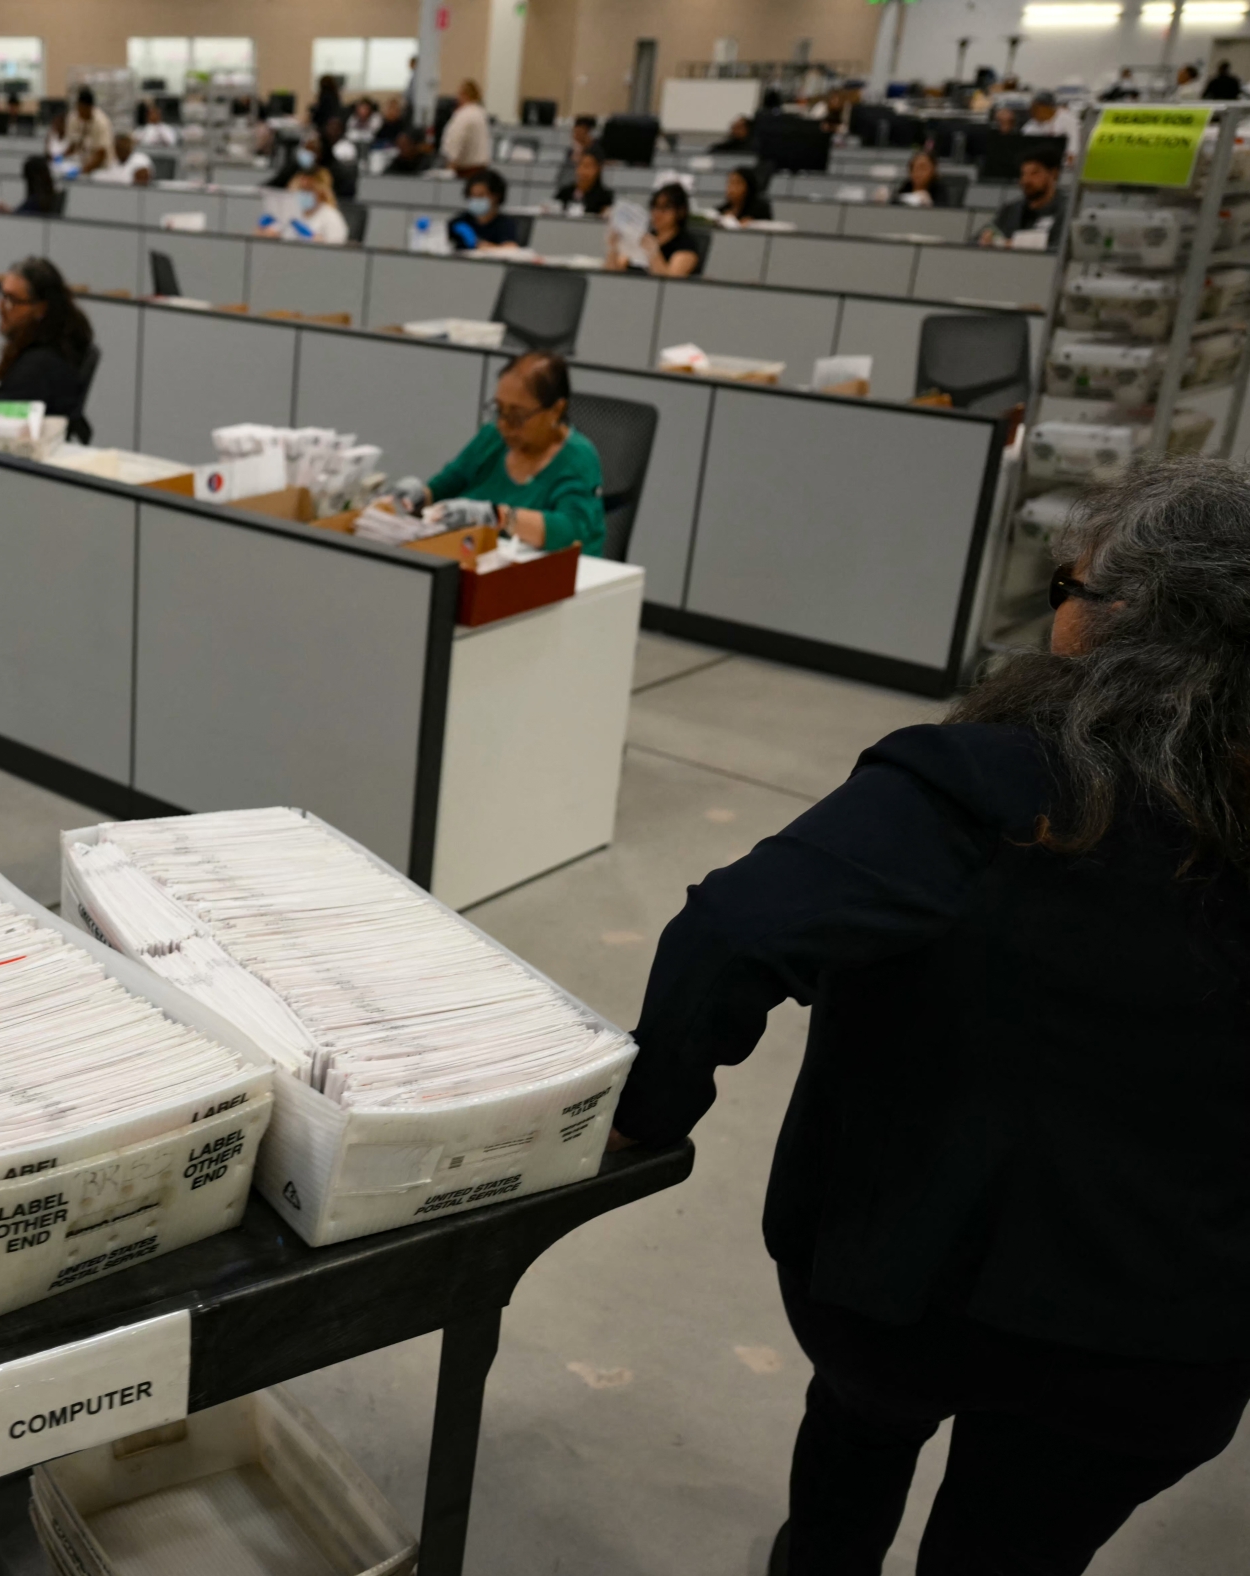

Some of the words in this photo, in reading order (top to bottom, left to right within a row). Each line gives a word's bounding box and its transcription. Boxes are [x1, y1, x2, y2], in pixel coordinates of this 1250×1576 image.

[183, 1143, 244, 1180] OTHER
[188, 1128, 246, 1163] LABEL
[190, 1164, 228, 1191] END
[425, 1185, 471, 1205] UNITED
[472, 1173, 522, 1194] STATES
[414, 1195, 464, 1216] POSTAL
[466, 1181, 521, 1204] SERVICE
[6, 1230, 51, 1254] END
[57, 1253, 107, 1279] UNITED
[108, 1235, 158, 1260] STATES
[47, 1266, 99, 1291] POSTAL
[102, 1243, 160, 1270] SERVICE
[9, 1381, 153, 1440] COMPUTER
